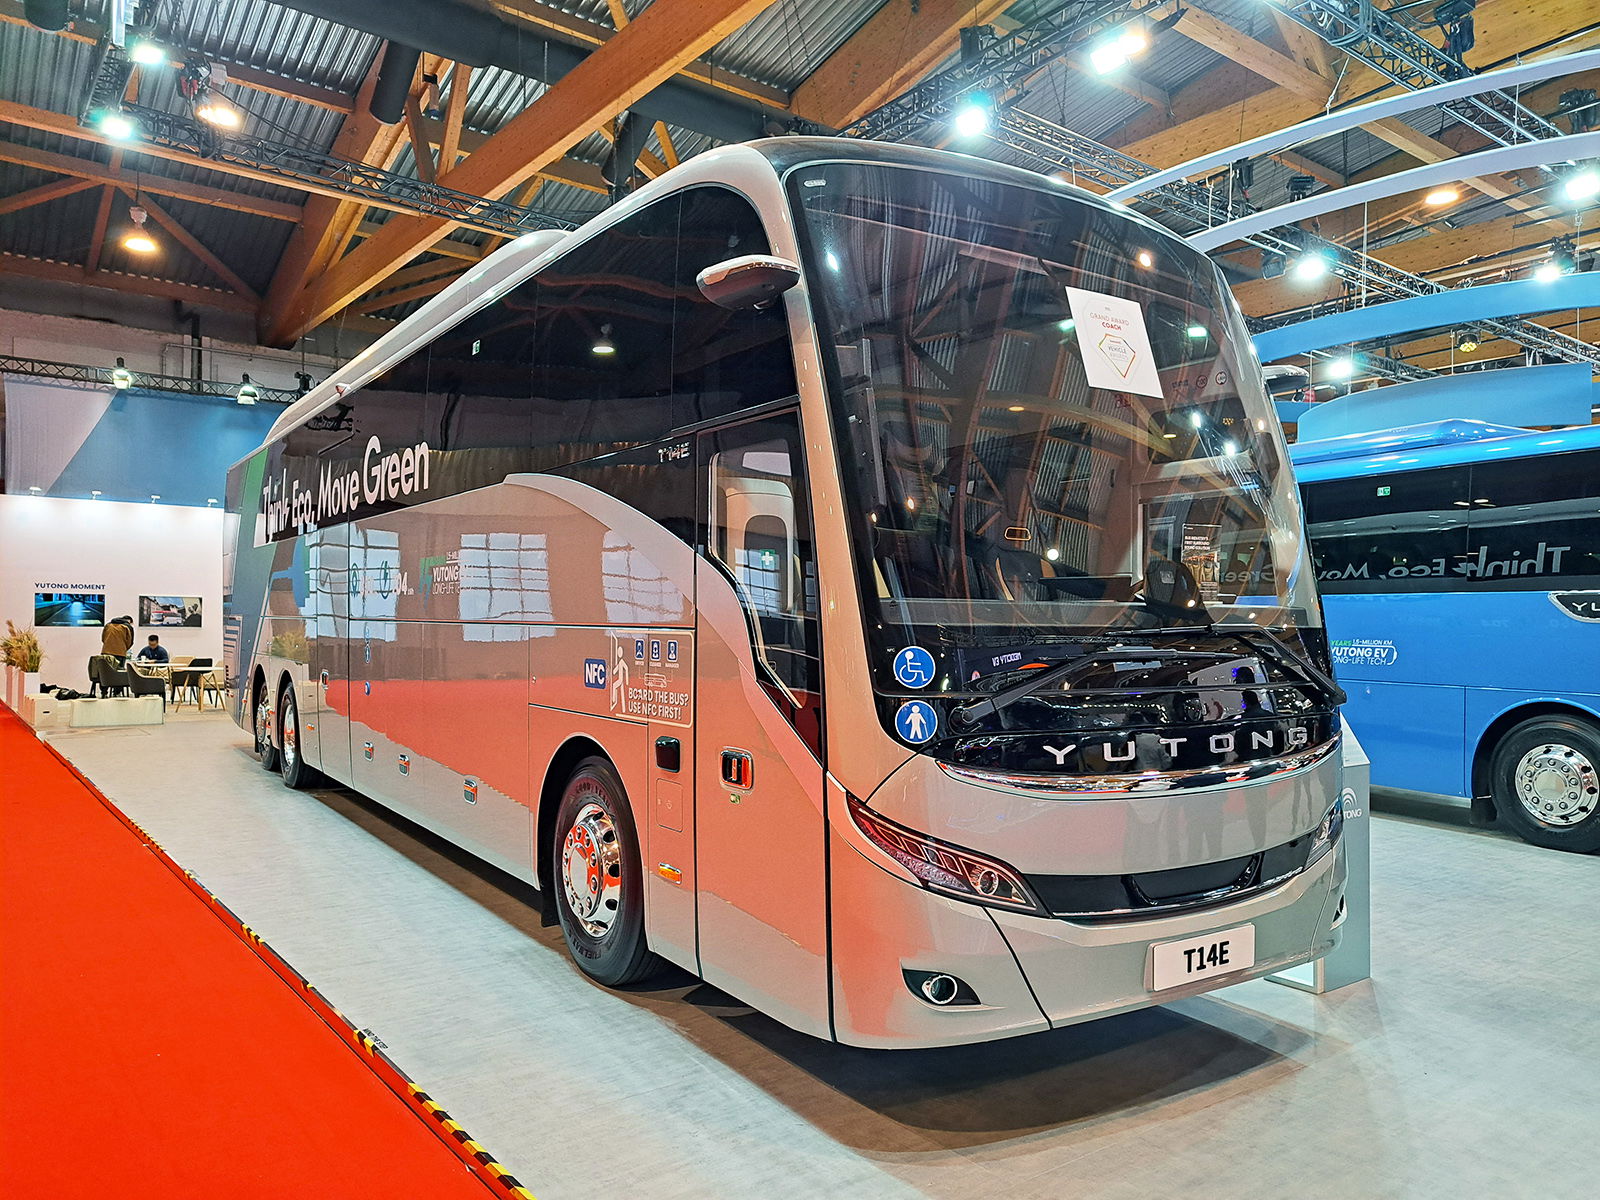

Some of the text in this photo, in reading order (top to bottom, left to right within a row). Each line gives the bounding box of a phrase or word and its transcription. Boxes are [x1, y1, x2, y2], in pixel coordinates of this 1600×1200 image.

[1101, 321, 1122, 331] COACH
[263, 435, 430, 541] Think Eco, Move Green
[432, 565, 460, 582] YUTONG
[34, 582, 106, 591] YUTONG MOMENT
[1353, 638, 1383, 646] 1.5-MILLION
[1333, 656, 1387, 666] ONG-LIFE TECH
[1373, 648, 1389, 658] EV
[585, 662, 605, 685] NFC
[628, 687, 689, 706] BOARD THE BUS?
[628, 701, 682, 720] USE NFC FIRST!
[1042, 726, 1308, 765] YUTONG
[1343, 808, 1362, 820] TONG
[1183, 940, 1230, 974] T14E
